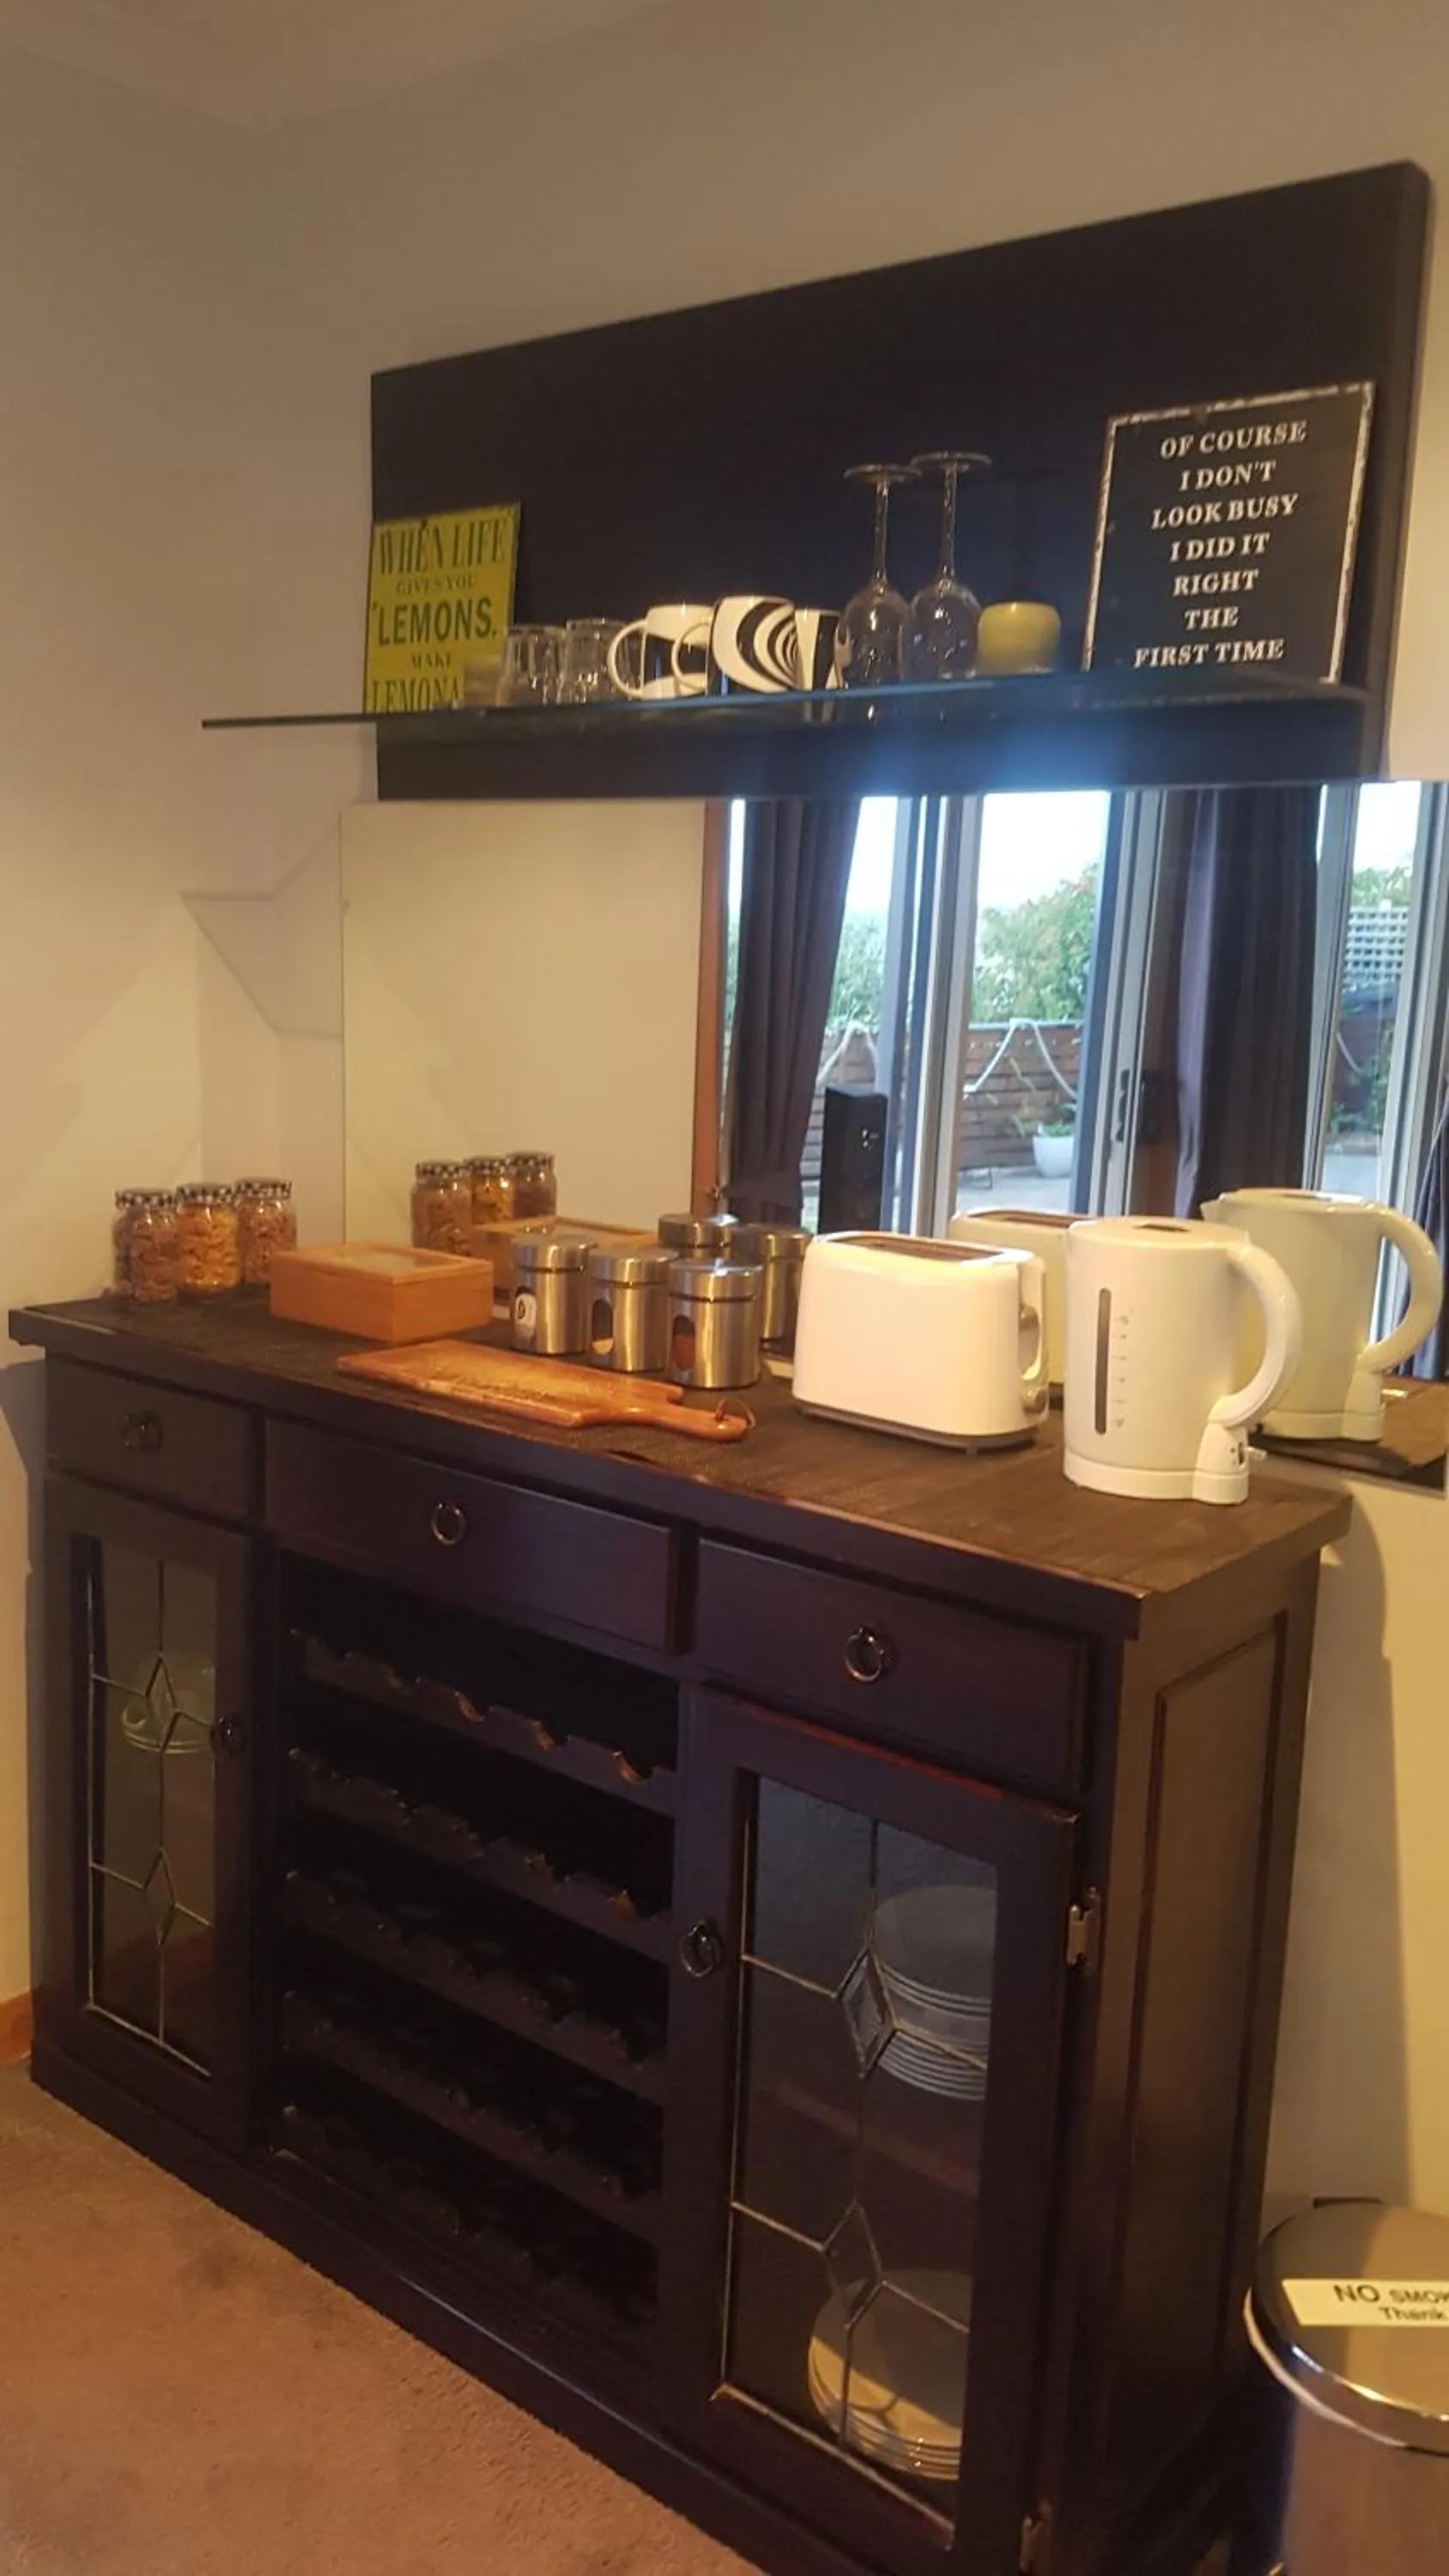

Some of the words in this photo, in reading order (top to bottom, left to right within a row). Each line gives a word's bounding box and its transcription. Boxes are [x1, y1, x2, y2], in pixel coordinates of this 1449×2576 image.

[1161, 434, 1193, 459] OF
[1199, 421, 1307, 453] COURSE
[1180, 471, 1191, 491] I
[1195, 460, 1276, 490] DON'T
[1151, 502, 1222, 530] LOOK
[1227, 494, 1299, 521] BUSY
[379, 525, 443, 574] WHEN
[452, 519, 506, 568] LIFE
[1170, 541, 1181, 562] I
[1185, 538, 1234, 560] DID
[1241, 532, 1270, 554] IT
[1173, 568, 1259, 596] RIGHT
[1184, 606, 1240, 630] THE
[1134, 645, 1209, 669] FIRST
[1215, 638, 1285, 663] TIME
[372, 675, 460, 713] LEMONA
[1333, 2284, 1380, 2302] NO
[1378, 2306, 1444, 2321] Thank
